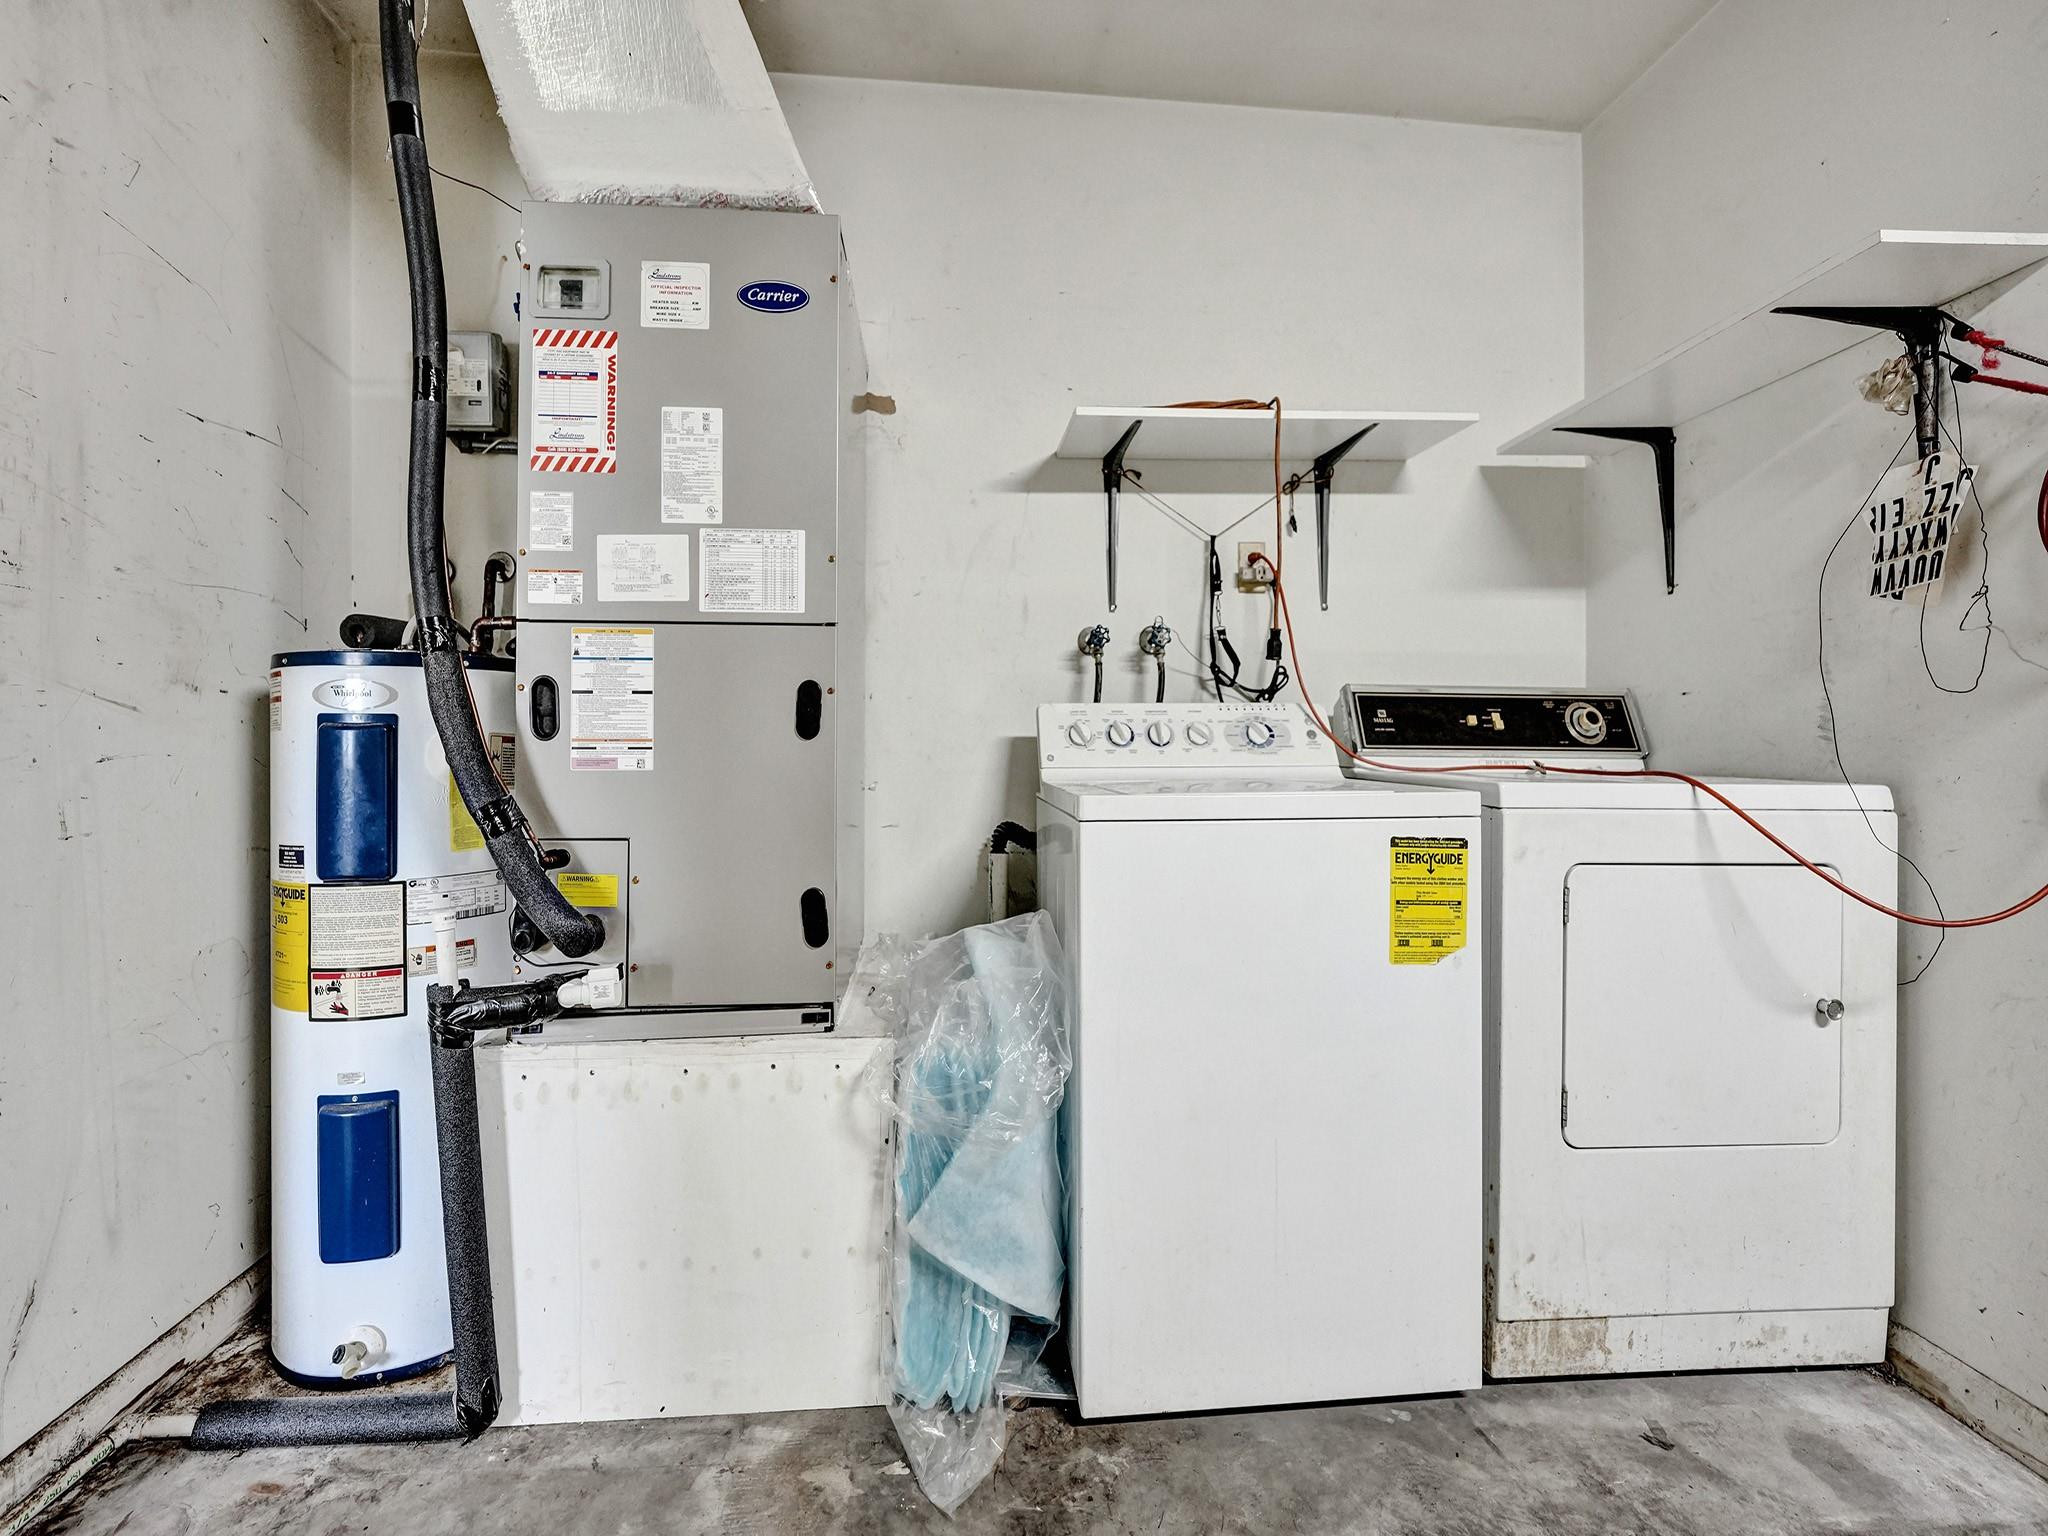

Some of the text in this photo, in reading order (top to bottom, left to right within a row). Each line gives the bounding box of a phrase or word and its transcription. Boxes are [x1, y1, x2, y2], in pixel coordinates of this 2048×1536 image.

[747, 288, 799, 303] Carrier
[607, 354, 616, 451] WARNING!
[1395, 852, 1463, 865] ENERGYGUIDE
[566, 875, 594, 883] WARNING
[346, 971, 378, 979] DANGER
